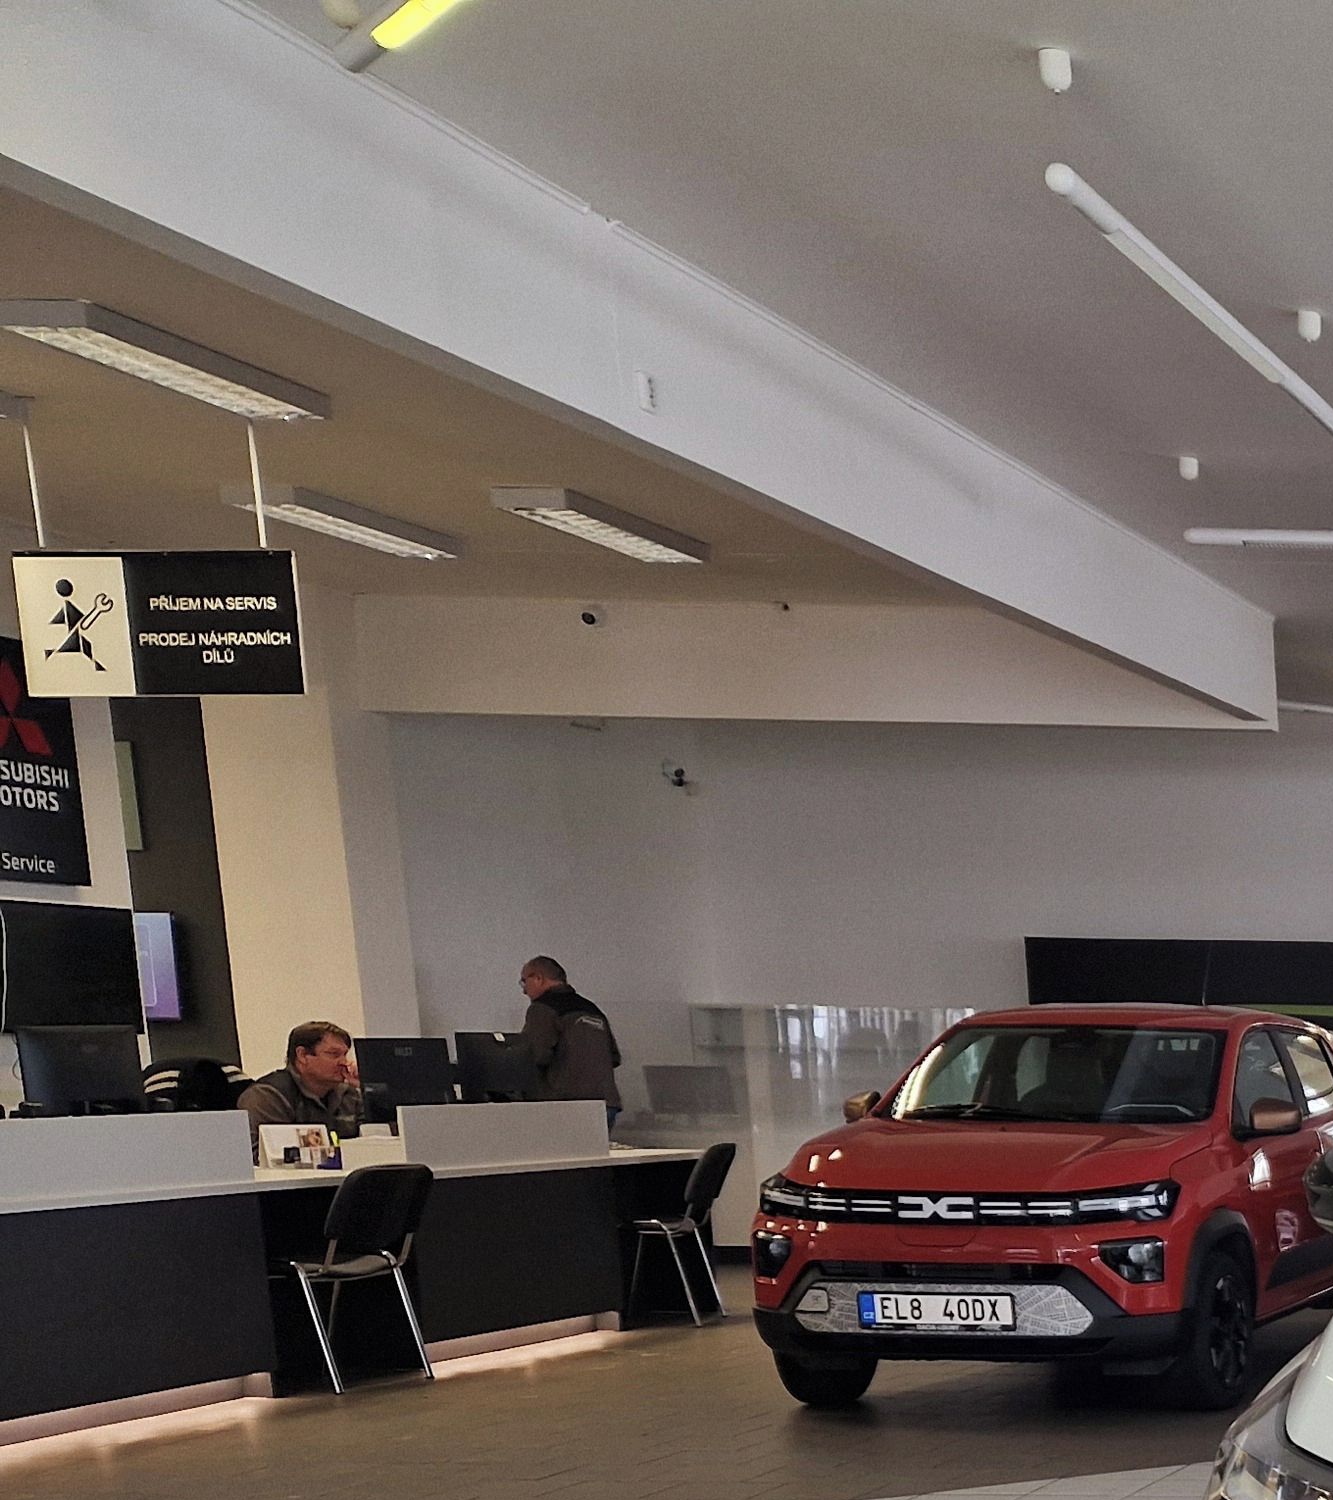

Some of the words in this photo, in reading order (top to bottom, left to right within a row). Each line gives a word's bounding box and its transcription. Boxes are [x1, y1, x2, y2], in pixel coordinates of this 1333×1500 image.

[149, 594, 200, 611] PŘÍJEM
[203, 597, 224, 611] NA
[225, 596, 278, 611] SERVIS
[138, 632, 195, 646] PRODEJ
[199, 629, 292, 646] NÁHRADNÍCH
[202, 647, 235, 664] DÍLŮ
[1, 852, 56, 874] Service
[880, 1297, 923, 1321] EL8
[943, 1298, 1000, 1322] 40DX
